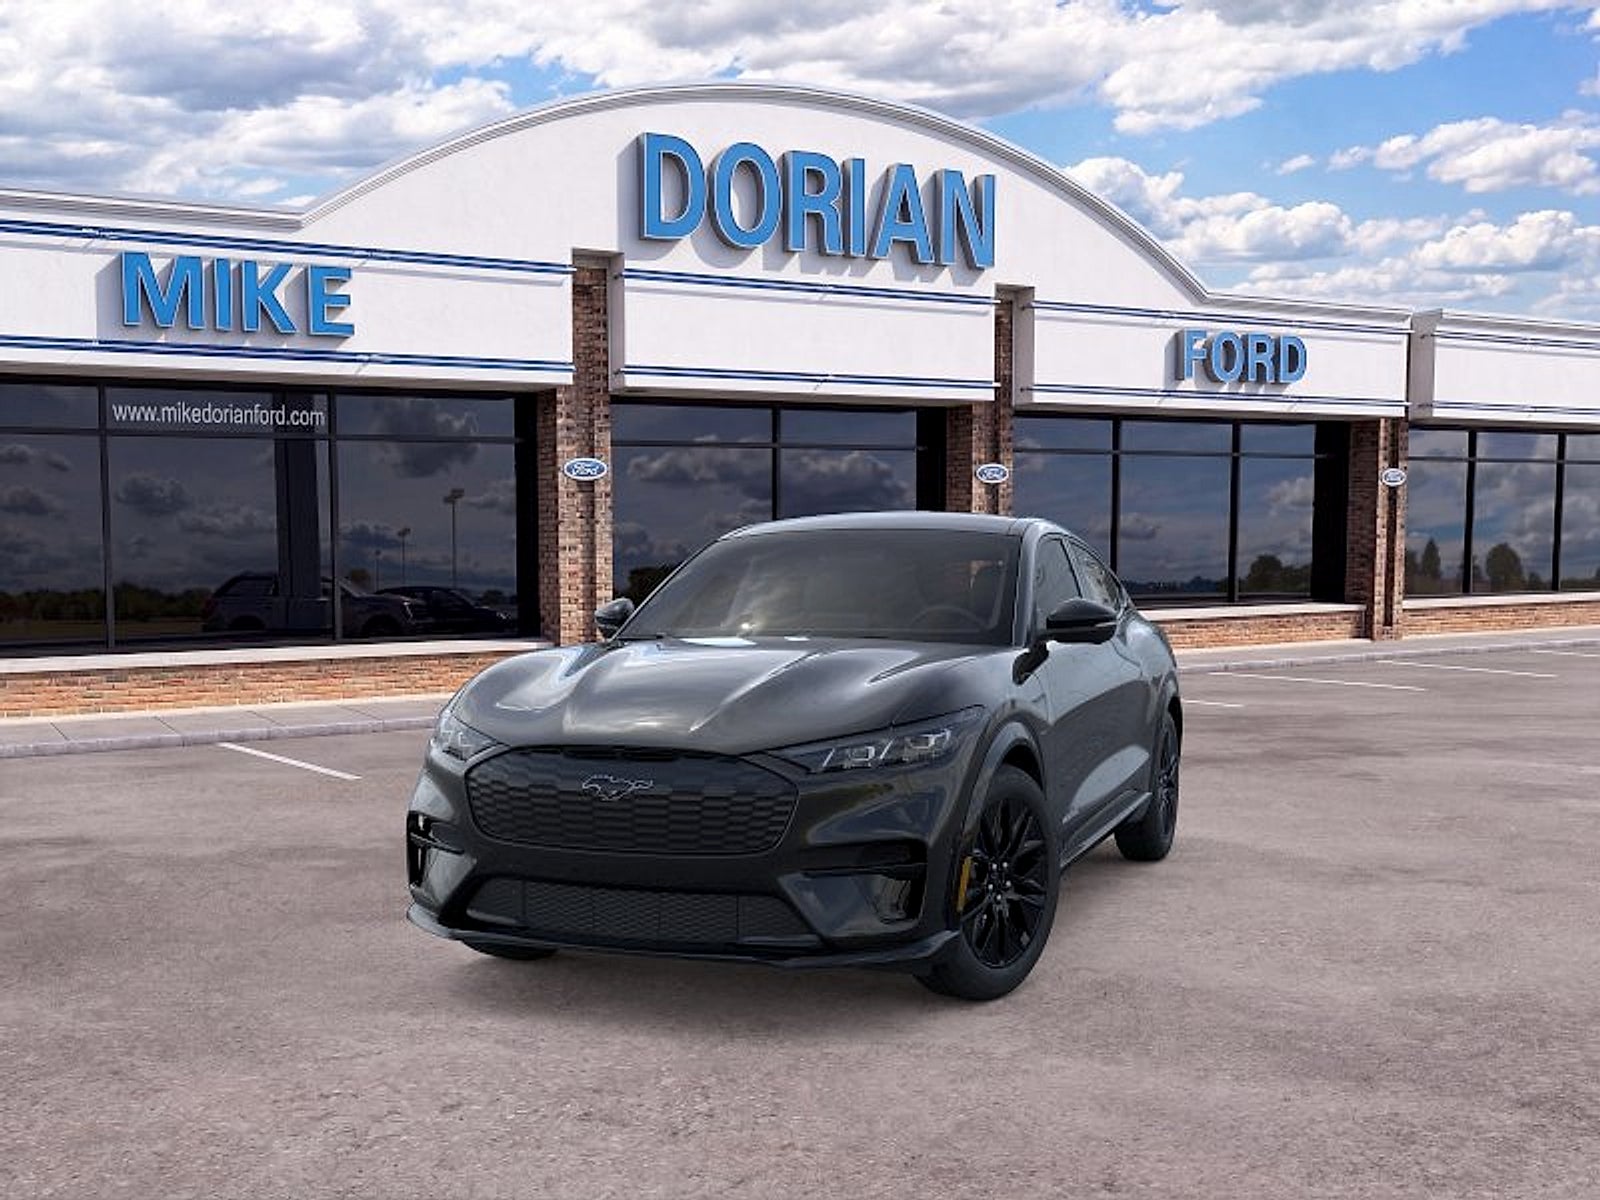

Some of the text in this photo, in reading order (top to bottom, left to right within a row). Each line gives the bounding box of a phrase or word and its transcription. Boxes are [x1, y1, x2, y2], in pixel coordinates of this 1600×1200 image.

[640, 132, 995, 270] DORIAN
[121, 251, 355, 338] MIKE
[1178, 328, 1307, 384] FORD
[112, 402, 325, 426] www.mikedorianford.com
